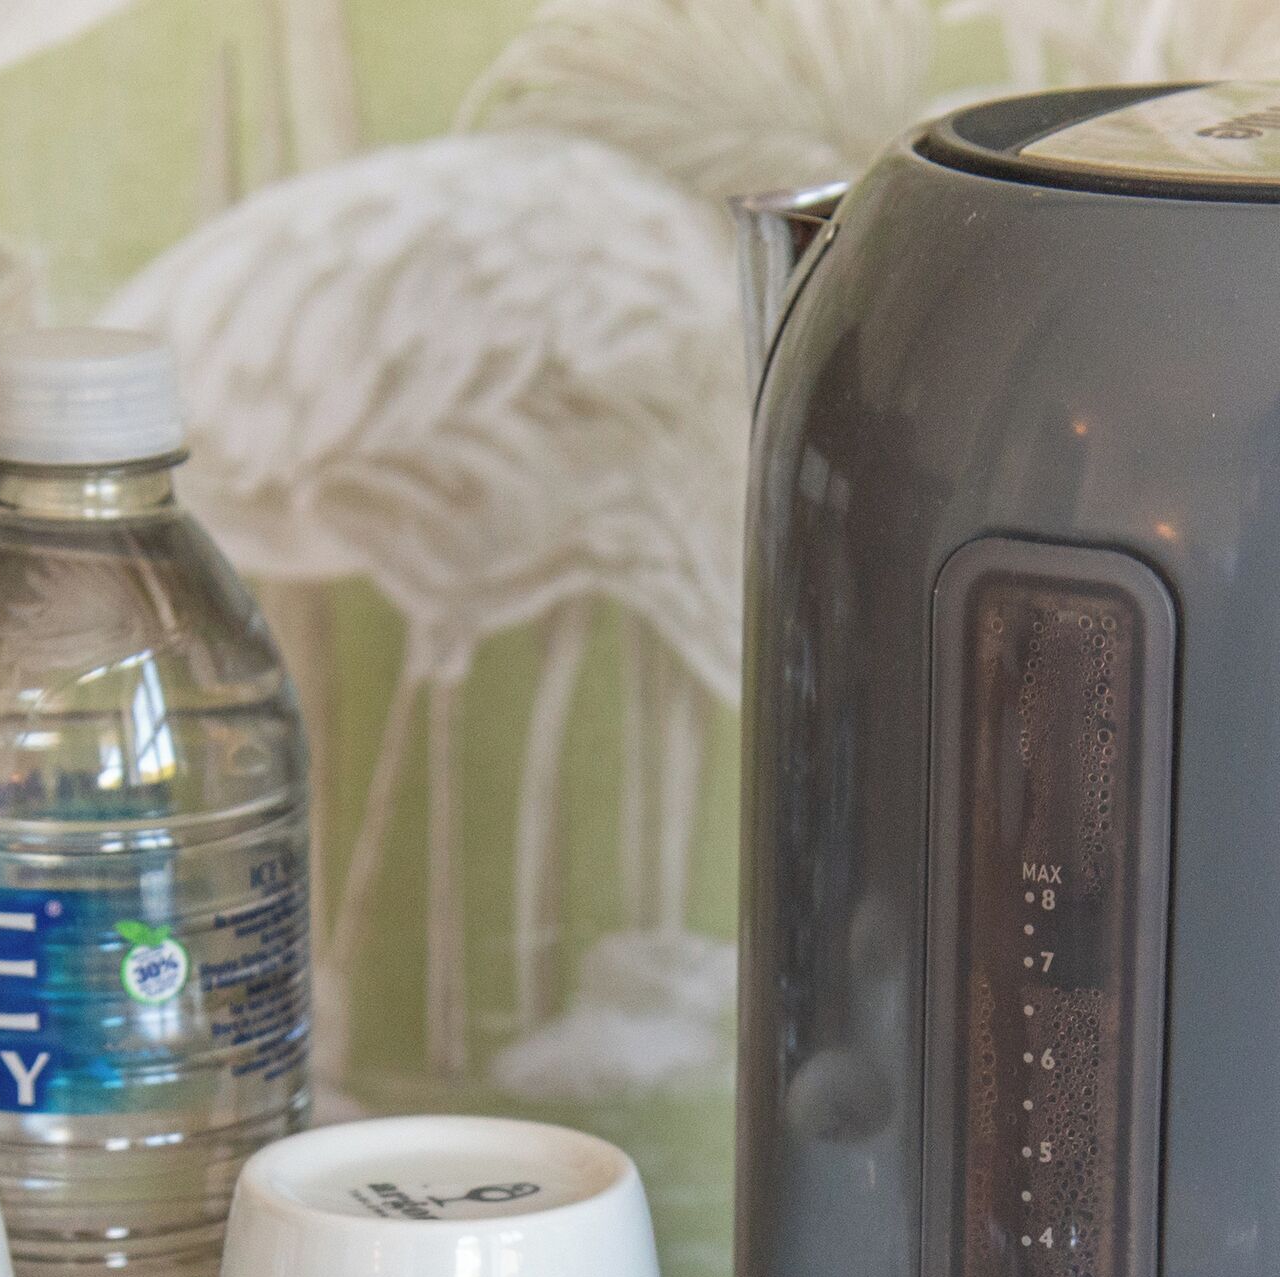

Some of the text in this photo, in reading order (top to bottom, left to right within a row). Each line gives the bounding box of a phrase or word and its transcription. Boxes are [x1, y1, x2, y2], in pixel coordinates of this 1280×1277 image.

[1022, 862, 1062, 884] MAX
[1042, 889, 1056, 910] 8
[1040, 951, 1055, 973] 7
[1041, 1047, 1056, 1070] 6
[1039, 1141, 1052, 1163] 5
[1039, 1227, 1054, 1249] 4
